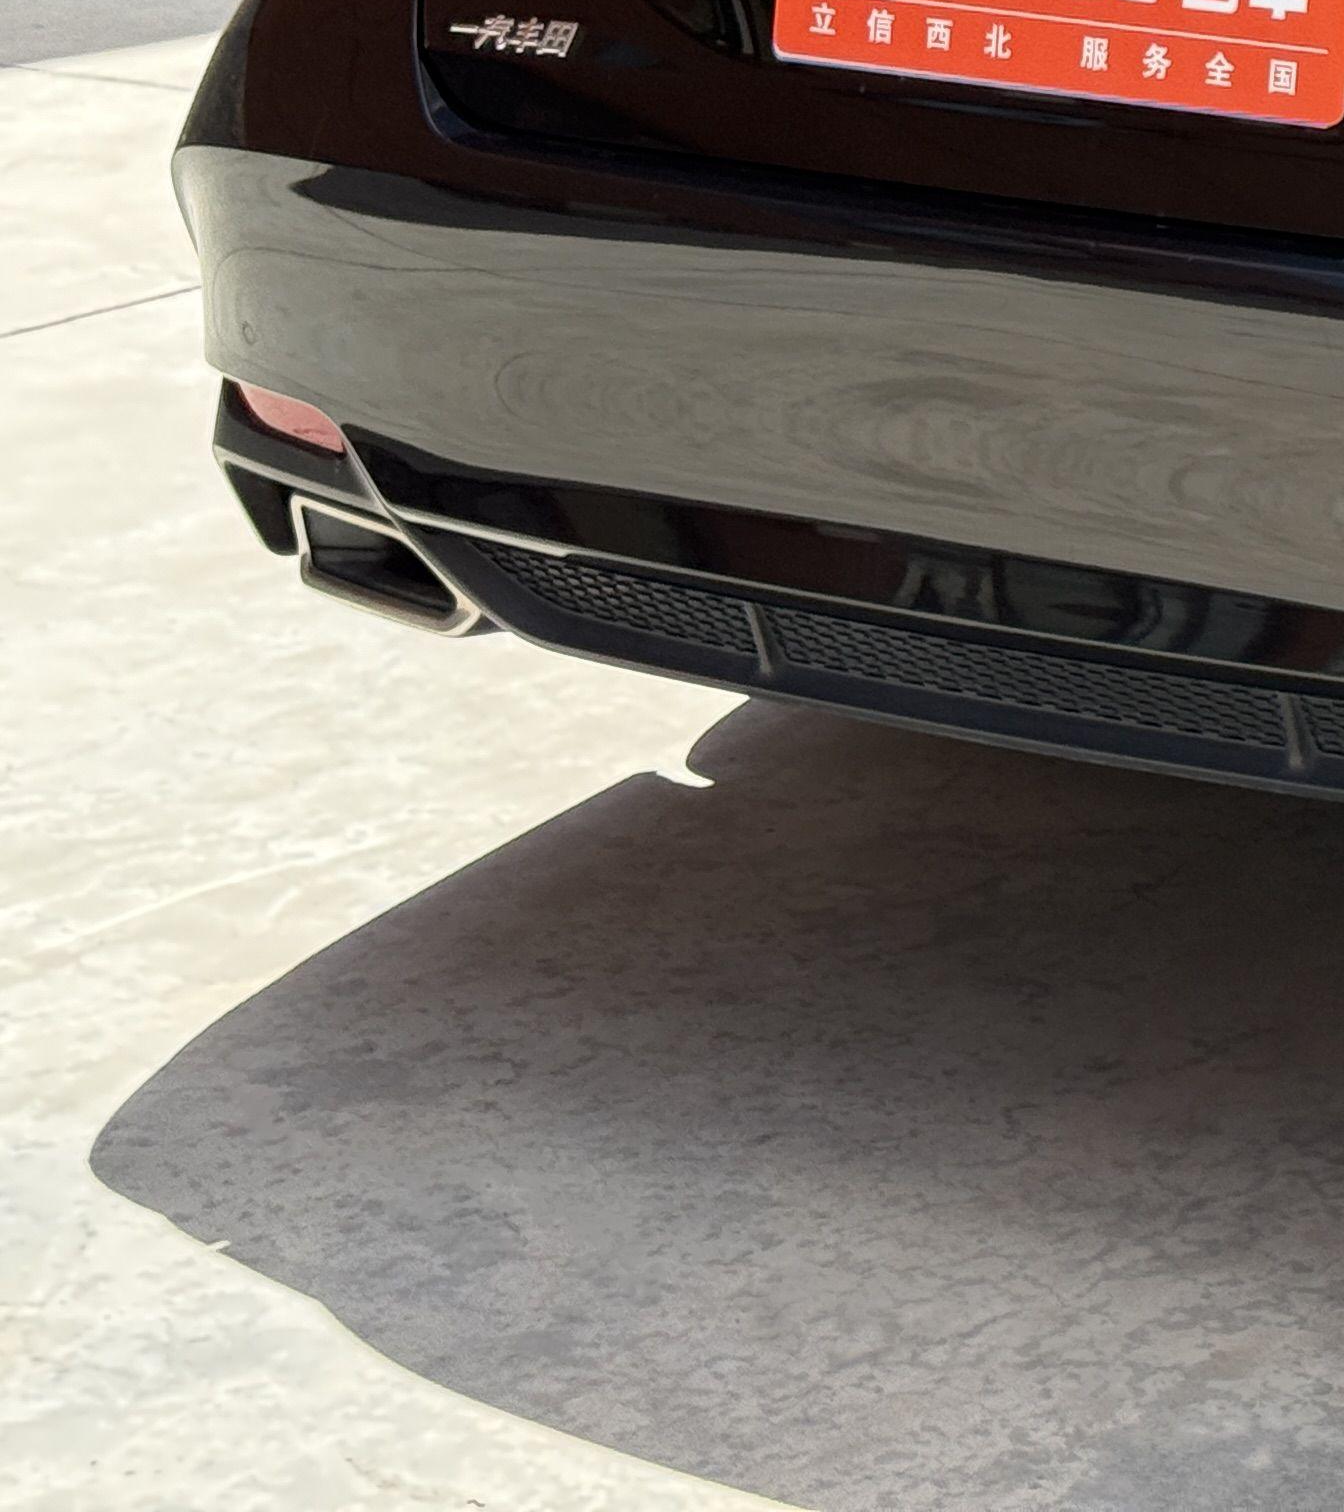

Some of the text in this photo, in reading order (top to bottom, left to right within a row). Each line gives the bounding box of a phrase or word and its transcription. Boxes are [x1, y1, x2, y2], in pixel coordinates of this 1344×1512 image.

[449, 14, 579, 58] 一汽丰田
[809, 2, 1299, 96] 立信西北 服务全国
